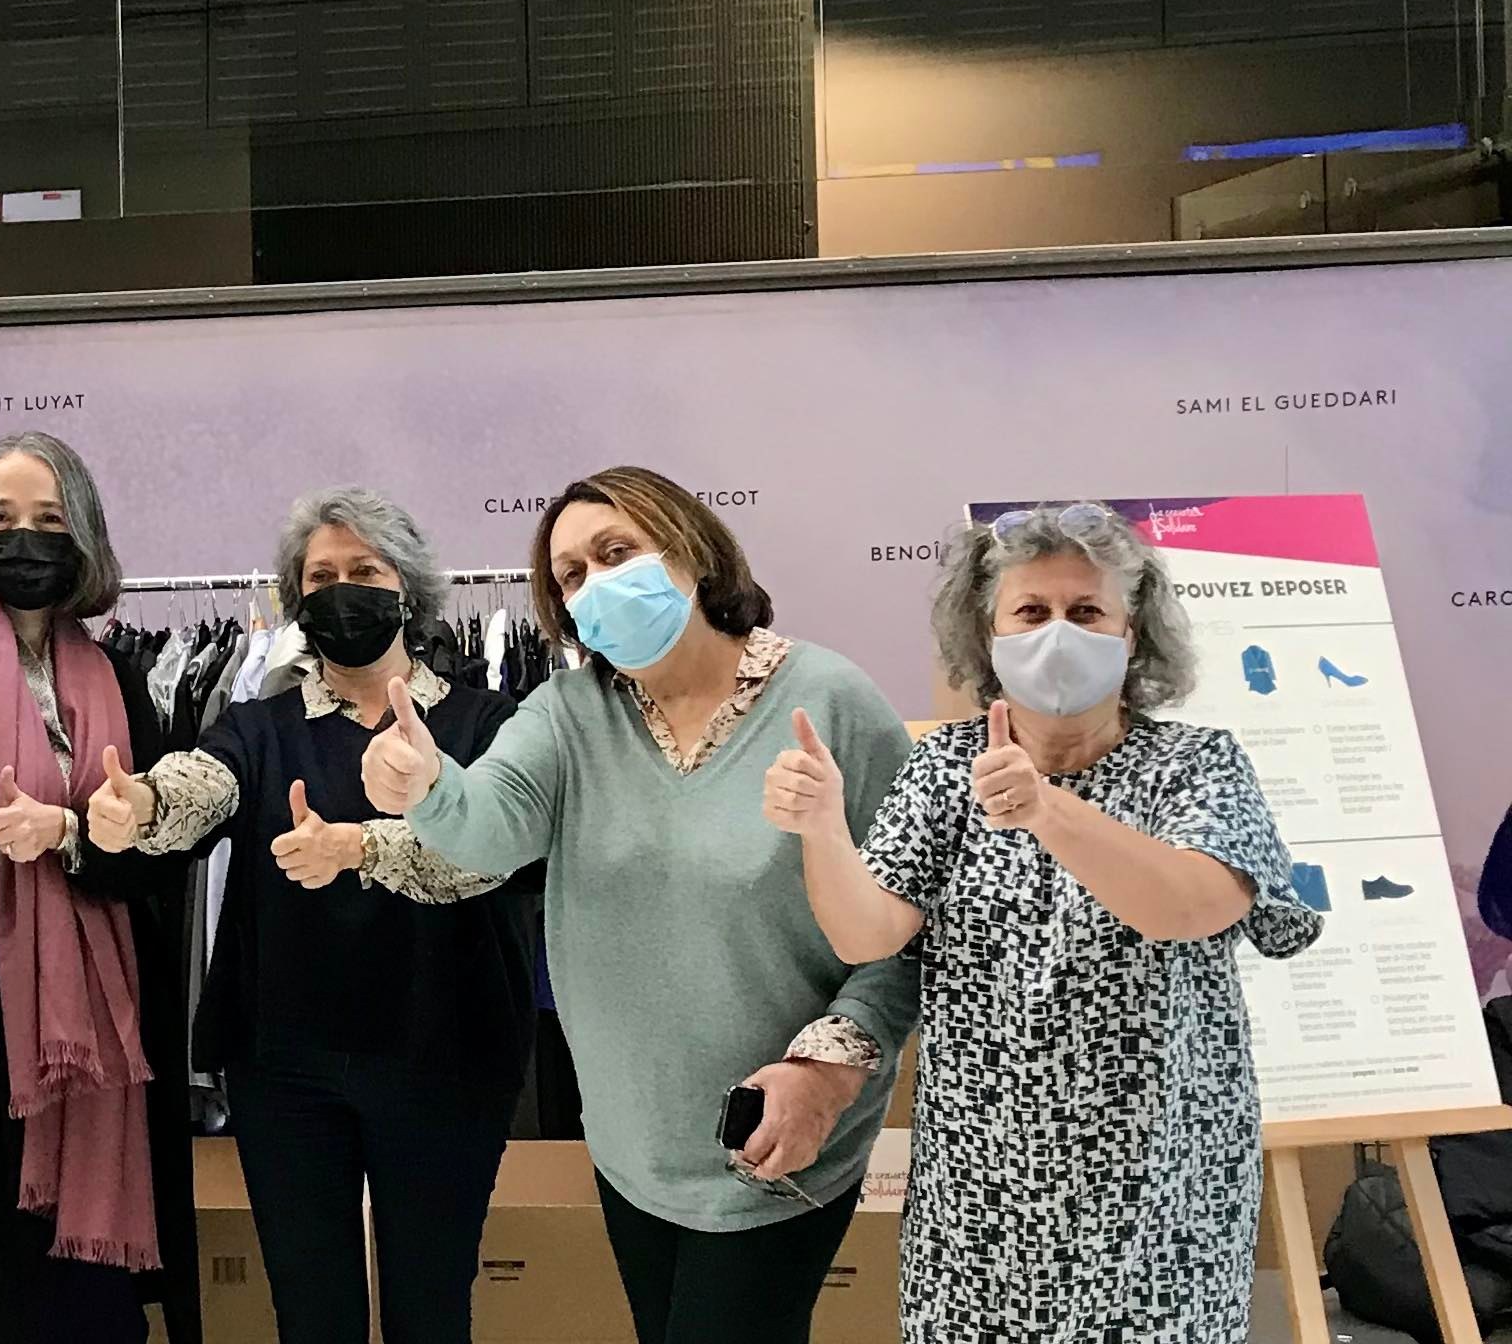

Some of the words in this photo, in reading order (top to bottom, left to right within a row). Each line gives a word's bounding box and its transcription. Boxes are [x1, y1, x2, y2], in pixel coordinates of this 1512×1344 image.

[24, 394, 85, 411] LUYAT
[1176, 397, 1230, 415] SAMI
[1241, 396, 1265, 412] EL
[1274, 389, 1396, 410] GUEDDARI
[1173, 581, 1253, 599] POUVEZ
[1261, 579, 1348, 597] DEPOSER
